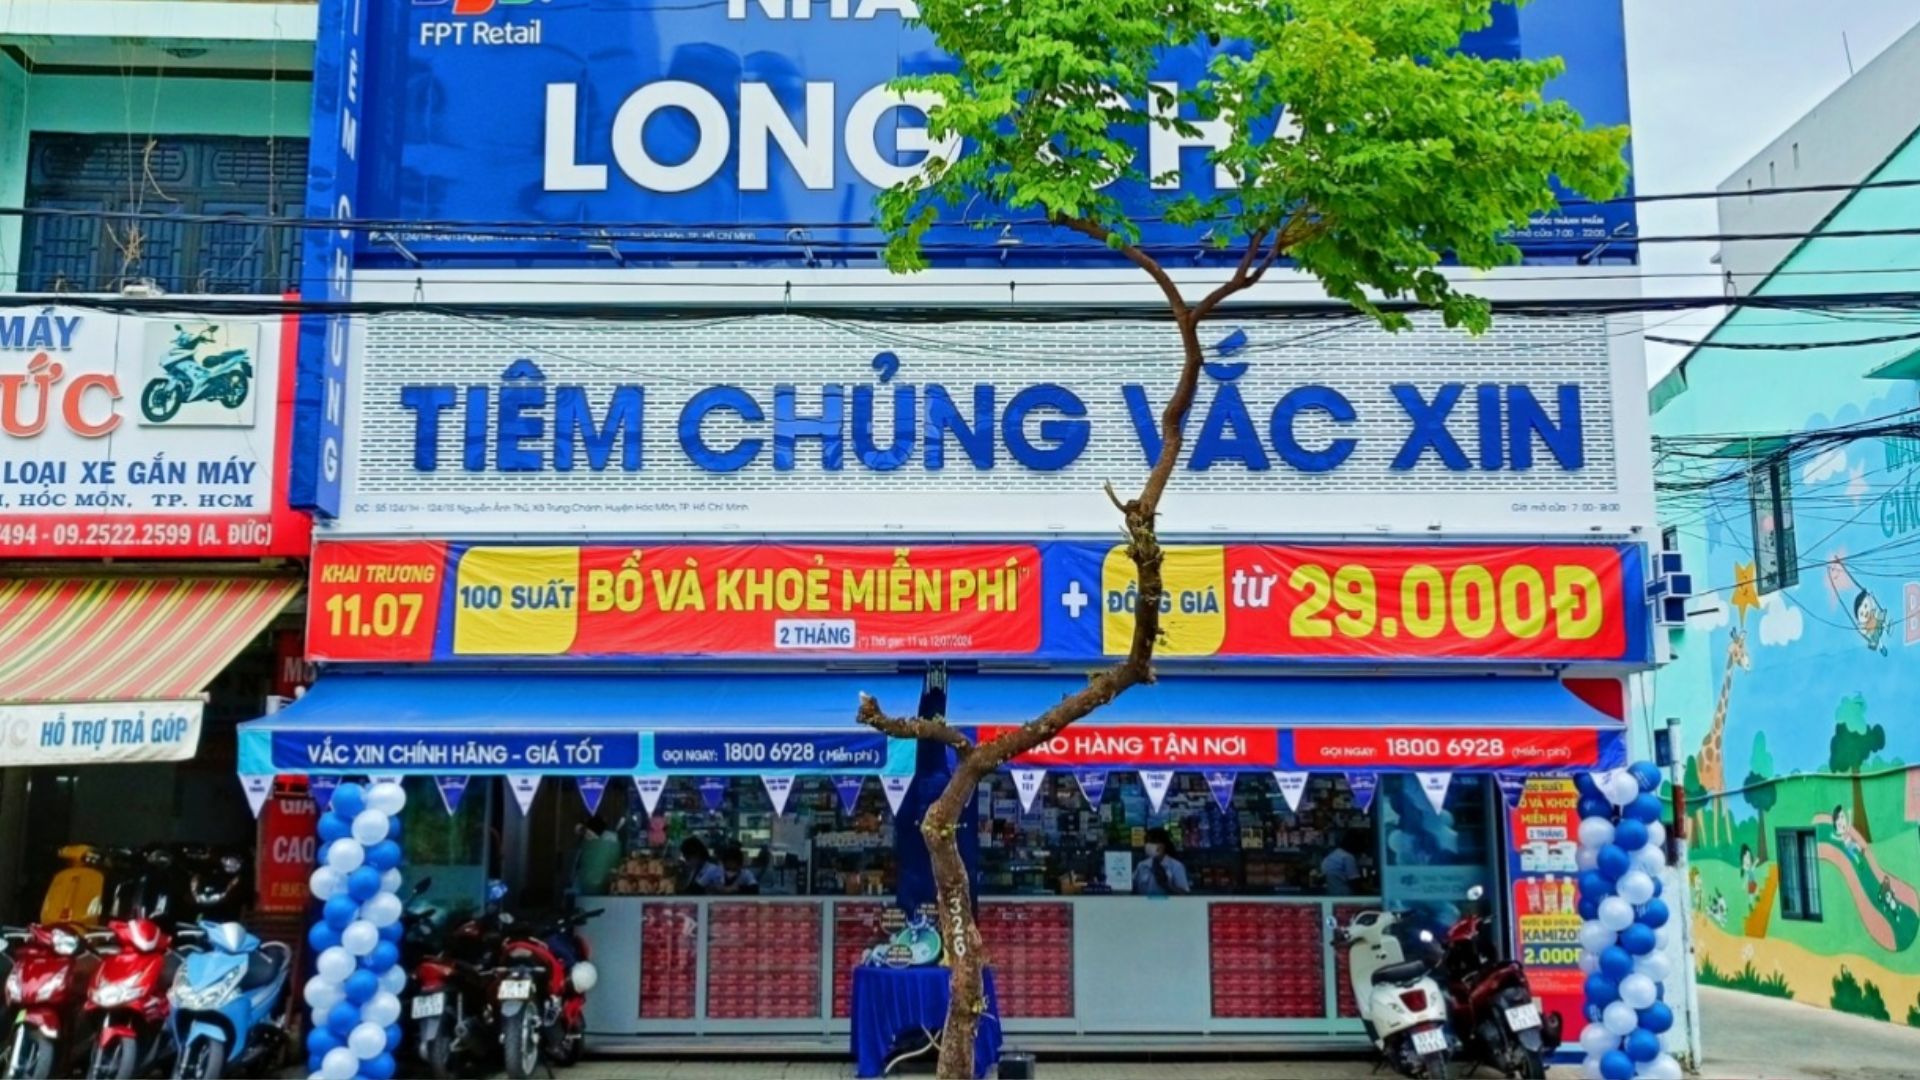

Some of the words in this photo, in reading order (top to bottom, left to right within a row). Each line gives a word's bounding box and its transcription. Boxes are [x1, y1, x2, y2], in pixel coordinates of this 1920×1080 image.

[420, 22, 467, 46] FPT
[472, 19, 541, 45] Retail
[543, 80, 963, 192] LONG
[0, 307, 81, 350] MÁY
[401, 359, 645, 472] TIÊM
[677, 351, 1091, 472] CHỦNG
[1121, 328, 1360, 473] VẮC
[1389, 383, 1584, 472] XIN
[4, 461, 66, 488] LOẠI
[80, 461, 116, 484] XE
[128, 452, 187, 485] GẮN
[197, 456, 257, 484] MÁY
[18, 490, 67, 507] HÓC
[151, 494, 188, 507] TP.
[198, 494, 254, 508] HCM
[0, 524, 36, 546] 494
[53, 524, 192, 546] 09.2522.2599
[321, 564, 361, 583] KHAI
[588, 549, 644, 612] BỔ
[651, 557, 706, 611] VÀ
[716, 554, 831, 612] KHOẺ
[842, 547, 943, 612] MIỄN
[950, 556, 1018, 612] PHÍ
[1231, 564, 1279, 608] từ
[460, 585, 502, 609] 100
[510, 579, 576, 609] SUẤT
[1106, 580, 1173, 613] ĐỒG
[1180, 585, 1220, 614] GIÁ
[1288, 563, 1603, 640] 29.000Đ
[325, 593, 424, 637] 11.07
[780, 627, 791, 645] 2
[794, 622, 851, 645] THÁNG
[40, 712, 66, 747] HỖ
[72, 717, 108, 750] TRỢ
[111, 710, 145, 745] TRẢ
[150, 712, 189, 743] GÓP
[1074, 733, 1144, 756] HÀNG
[1149, 732, 1201, 760] TẬN
[1203, 737, 1247, 756] NƠI
[307, 736, 350, 765] VẮC
[353, 744, 386, 764] XIN
[388, 738, 449, 764] CHÍNH
[452, 740, 508, 764] HÃNG
[524, 738, 560, 764] GIÁ
[563, 737, 604, 764] TỐT
[662, 750, 684, 764] GỌI
[685, 750, 719, 762] NGAY:
[723, 742, 766, 762] 1800
[769, 742, 815, 762] 6928
[1320, 746, 1343, 758] GỌI
[1385, 738, 1440, 757] 1800
[1446, 738, 1505, 757] 6928
